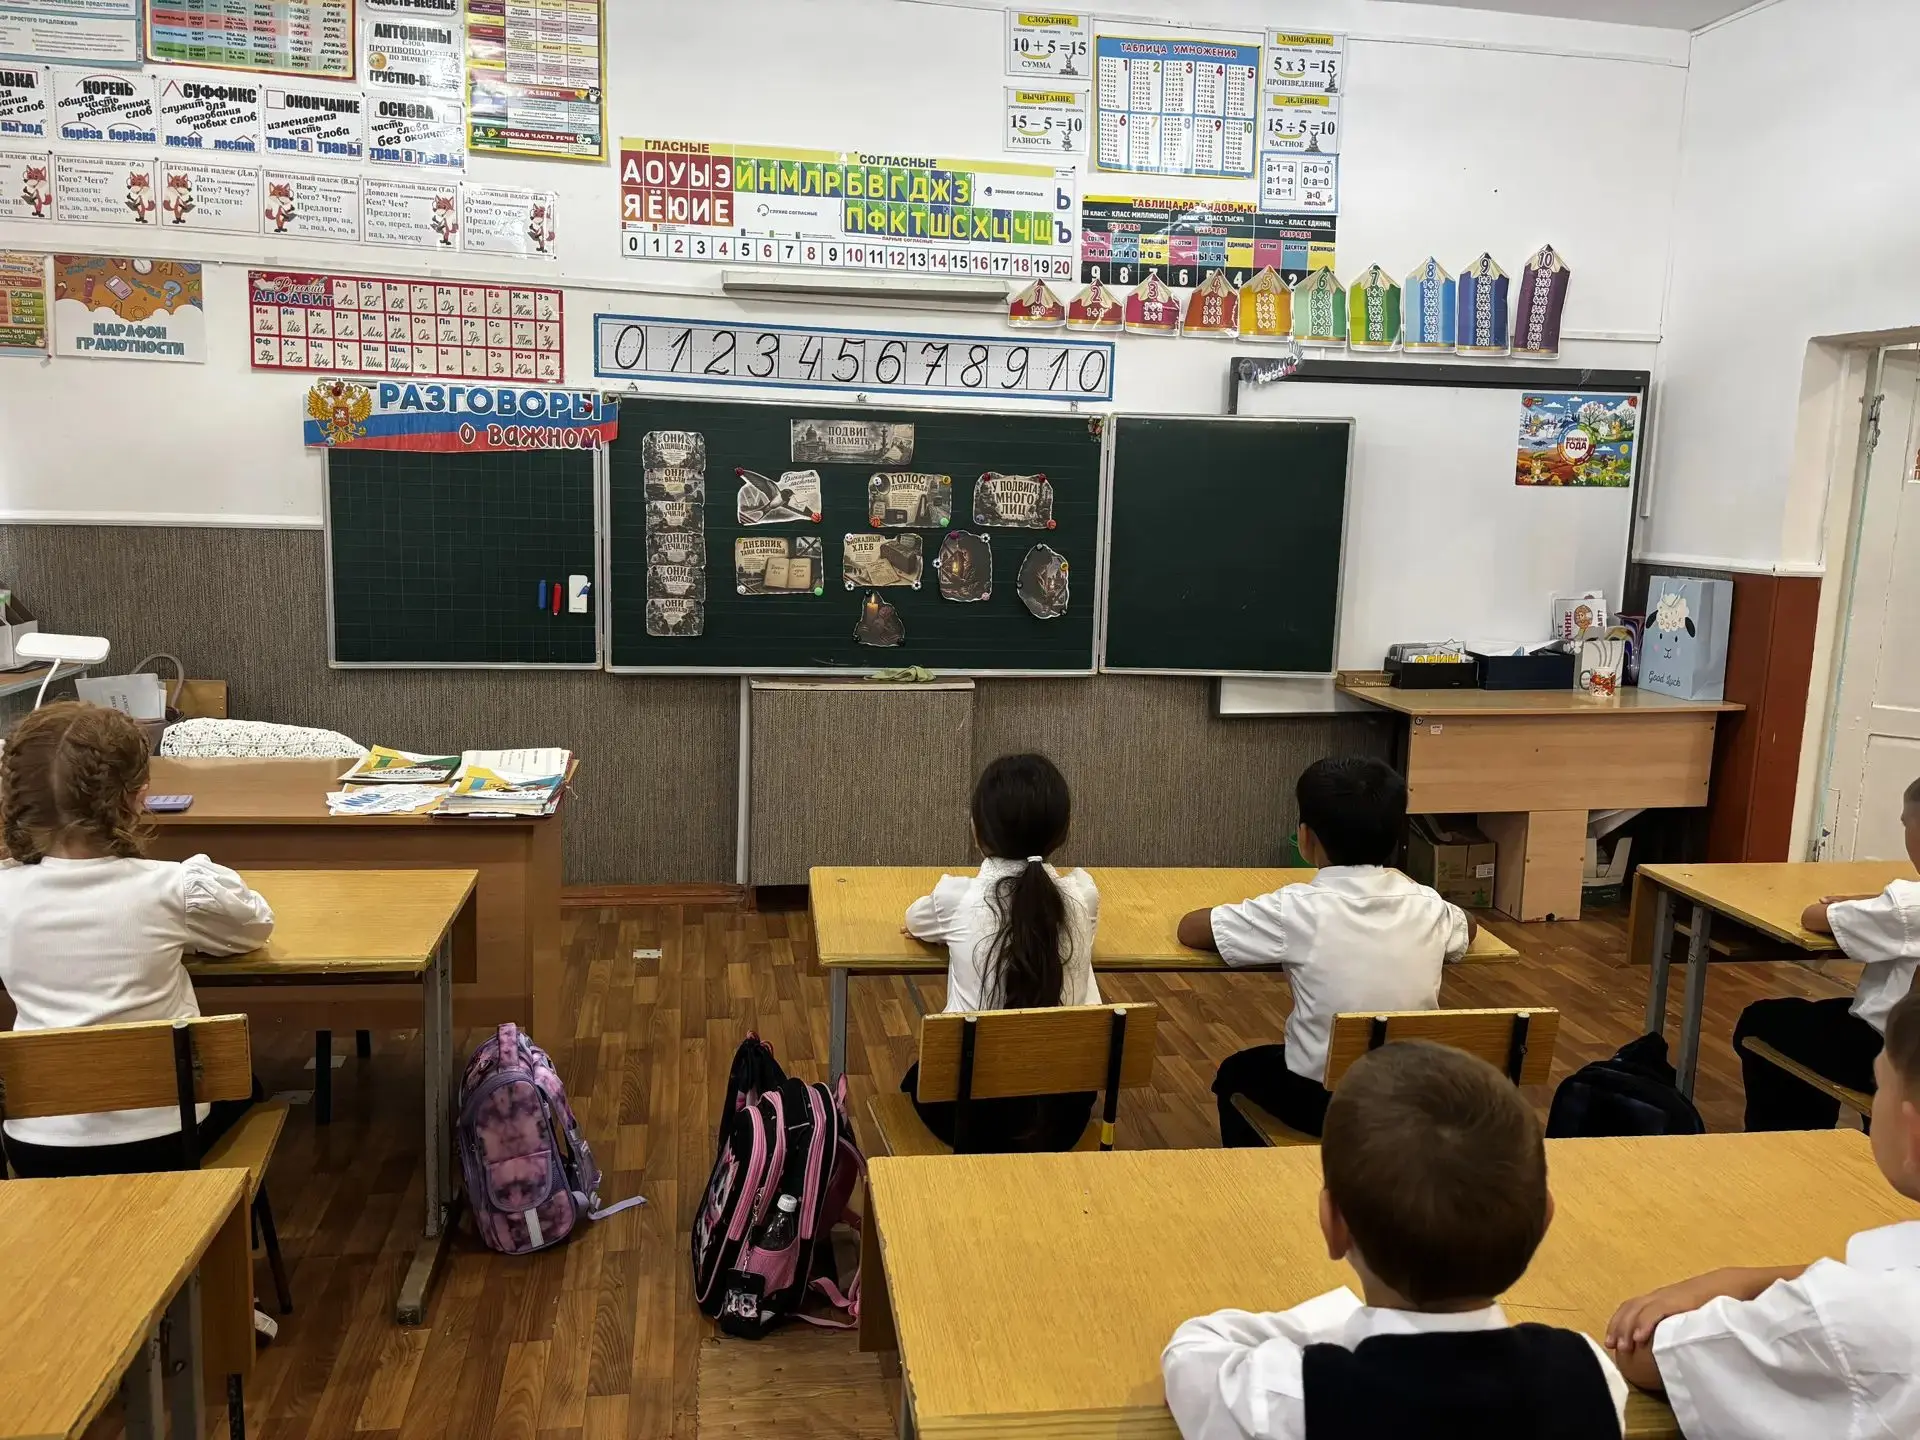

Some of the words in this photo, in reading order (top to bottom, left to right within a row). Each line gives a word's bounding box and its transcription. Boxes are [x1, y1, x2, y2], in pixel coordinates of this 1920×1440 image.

[1028, 16, 1072, 25] СЛОЖЕНИЕ
[374, 23, 451, 44] АНТОНИМЫ
[1281, 35, 1330, 45] УМНОЖЕНИЕ
[1120, 42, 1167, 55] ТАБЛИЦА
[1174, 46, 1237, 58] УМНОЖЕНИЯ
[1022, 61, 1051, 69] СУММА
[83, 80, 134, 96] КОРЕНЬ
[1267, 78, 1324, 88] ПРОИЗВЕДЕНИЕ
[183, 83, 256, 104] СУФФИКС
[1022, 93, 1071, 103] ВЫЧИТАНИЕ
[58, 94, 94, 108] общая
[85, 97, 118, 110] часть
[162, 98, 205, 114] служит
[286, 94, 359, 114] ОКОНЧАНИЕ
[1285, 96, 1319, 105] ДЕЛЕНИЕ
[17, 100, 44, 113] слов
[77, 99, 150, 121] родственных
[126, 105, 152, 119] слов
[206, 102, 226, 112] для
[380, 101, 434, 120] ОСНОВА
[176, 108, 241, 125] образования
[194, 118, 227, 130] новых
[231, 112, 257, 125] слов
[267, 113, 336, 130] изменяемая
[288, 124, 321, 135] часть
[372, 120, 403, 131] часть
[397, 122, 429, 134] слова
[62, 127, 103, 140] берёза
[109, 128, 156, 142] берёзка
[317, 127, 350, 139] слова
[500, 130, 530, 139] ОСОБАЯ
[532, 132, 555, 140] ЧАСТЬ
[166, 136, 202, 148] лесок
[214, 139, 255, 152] лесник
[378, 135, 401, 146] без
[1012, 136, 1051, 145] РАЗНОСТЬ
[1269, 139, 1304, 148] ЧАСТНОЕ
[644, 139, 710, 154] ГЛАСНЫЕ
[859, 154, 937, 169] СОГЛАСНЫЕ
[163, 163, 208, 173] Дательный
[211, 168, 236, 176] падеж
[623, 159, 642, 183] А
[646, 160, 664, 184] О
[669, 162, 686, 185] У
[691, 163, 709, 187] Ы
[715, 165, 731, 188] Э
[58, 175, 82, 183] Кого?
[195, 175, 215, 183] Дать
[265, 171, 315, 181] Винительный
[59, 185, 101, 194] Предлоги:
[196, 185, 222, 194] Кому?
[225, 187, 250, 196] Чему?
[296, 183, 317, 191] Вижу
[296, 192, 319, 201] Кого?
[365, 189, 398, 198] Доволен
[197, 195, 243, 206] Предлоги:
[366, 198, 386, 206] Кем?
[388, 200, 408, 208] Чем?
[465, 197, 492, 206] Думаю
[1132, 199, 1178, 210] ТАБЛИЦА
[297, 203, 342, 213] Предлоги:
[624, 194, 640, 218] Я
[649, 190, 662, 219] Ё
[668, 196, 688, 220] Ю
[693, 198, 709, 222] И
[715, 199, 729, 223] Е
[367, 208, 411, 219] Предлоги:
[629, 237, 638, 249] 0
[653, 238, 660, 252] 1
[675, 239, 683, 253] 2
[697, 241, 705, 254] 3
[719, 242, 728, 256] 4
[742, 243, 750, 256] 5
[764, 244, 772, 258] 6
[786, 246, 794, 259] 7
[807, 247, 816, 260] 8
[829, 247, 837, 261] 9
[847, 248, 863, 263] 10
[869, 250, 883, 264] 11
[889, 251, 905, 266] 12
[910, 252, 925, 266] 13
[930, 254, 947, 268] 14
[951, 255, 967, 269] 15
[972, 256, 988, 270] 16
[993, 256, 1008, 271] 17
[1014, 258, 1029, 272] 18
[1034, 259, 1049, 273] 19
[1054, 260, 1069, 274] 20
[273, 276, 325, 293] Русский
[254, 291, 334, 306] АЛФАВИТ
[93, 323, 167, 340] МАРАФОН
[76, 336, 185, 355] ГРАМОТНОСТИ
[615, 325, 645, 369] 0
[671, 328, 692, 372] 1
[704, 331, 736, 375] 2
[747, 333, 779, 377] 3
[799, 336, 821, 380] 4
[832, 338, 865, 381] 5
[877, 340, 906, 383] 6
[921, 343, 949, 385] 7
[960, 345, 988, 387] 8
[1001, 347, 1028, 388] 9
[379, 382, 601, 420] РАЗГОВОРЫ
[828, 426, 869, 436] ПОДВИГ
[663, 434, 684, 443] ОНИ
[828, 437, 835, 445] И
[836, 437, 870, 446] ПАМЯТЬ
[891, 474, 925, 484] ГОЛОС
[992, 481, 997, 492] У
[1000, 481, 1038, 494] ПОДВИГА
[996, 492, 1034, 505] МНОГО
[1001, 504, 1026, 516] ЛИЦ
[666, 534, 687, 543] ОНИ
[743, 540, 782, 549] ДНЕВНИК
[852, 543, 874, 552] ХЛЕБ
[667, 567, 687, 576] ОНИ
[1648, 670, 1665, 684] Good
